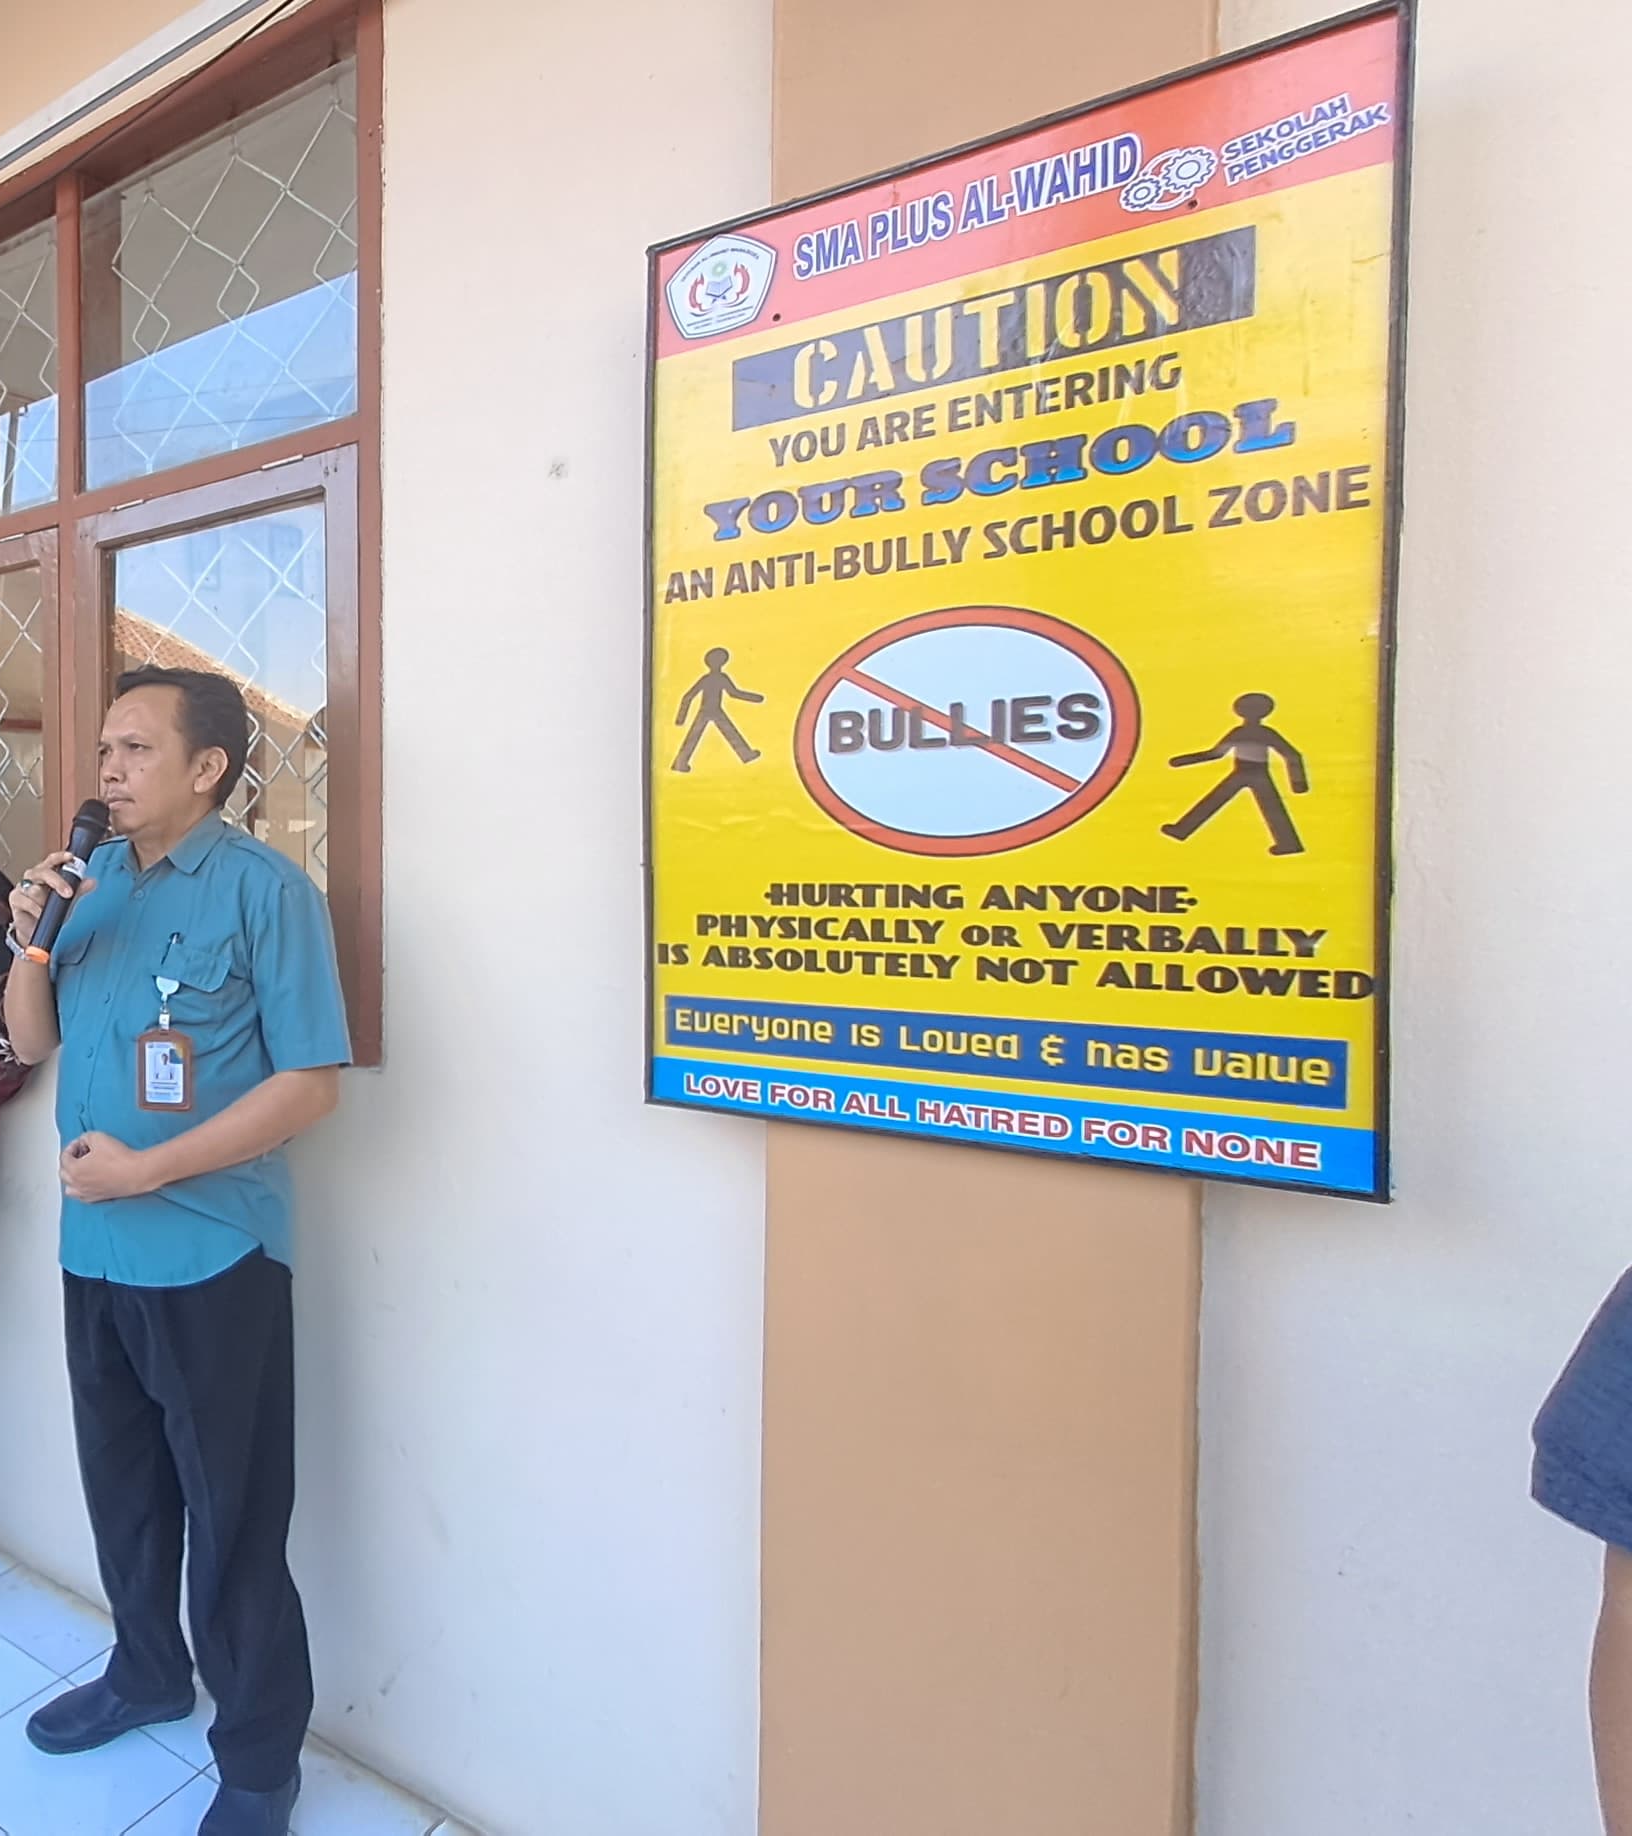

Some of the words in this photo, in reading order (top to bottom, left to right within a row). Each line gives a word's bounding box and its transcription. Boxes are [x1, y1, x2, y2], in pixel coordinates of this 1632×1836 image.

[1221, 95, 1350, 162] SEKOLAH
[1225, 102, 1390, 186] PENGGERAK
[793, 226, 861, 281] SMA
[870, 201, 952, 260] PLUS
[960, 133, 1144, 233] AL-WAHID
[793, 250, 1181, 409] CAUTION
[769, 422, 846, 468] YOU
[856, 404, 937, 451] ARE
[948, 352, 1183, 432] ENTERING
[704, 469, 906, 542] YOUR
[921, 398, 1296, 506] SCHOOL
[665, 570, 715, 605] AN
[723, 524, 974, 597] ANTI-BULLY
[983, 495, 1194, 559] SCHOOL
[1207, 464, 1372, 530] ZONE
[828, 692, 1101, 754] BULLIES
[658, 943, 690, 966] IS
[702, 947, 960, 982] ABSOLUTELY
[976, 956, 1079, 987] NOT
[1096, 962, 1373, 1000] ALLOWED
[696, 914, 945, 947] PHYSICALLY
[960, 924, 1021, 949] OR
[1038, 922, 1328, 959] VERBALLY
[674, 1007, 835, 1044] Everyone
[899, 1025, 1022, 1060] Loved
[1039, 1033, 1066, 1066] &
[684, 1073, 760, 1103] LOVE
[769, 1082, 837, 1113] FOR
[843, 1089, 910, 1121] ALL
[917, 1099, 1070, 1141] HATRED
[1081, 1117, 1171, 1151] FOR
[1182, 1131, 1321, 1169] NONE
